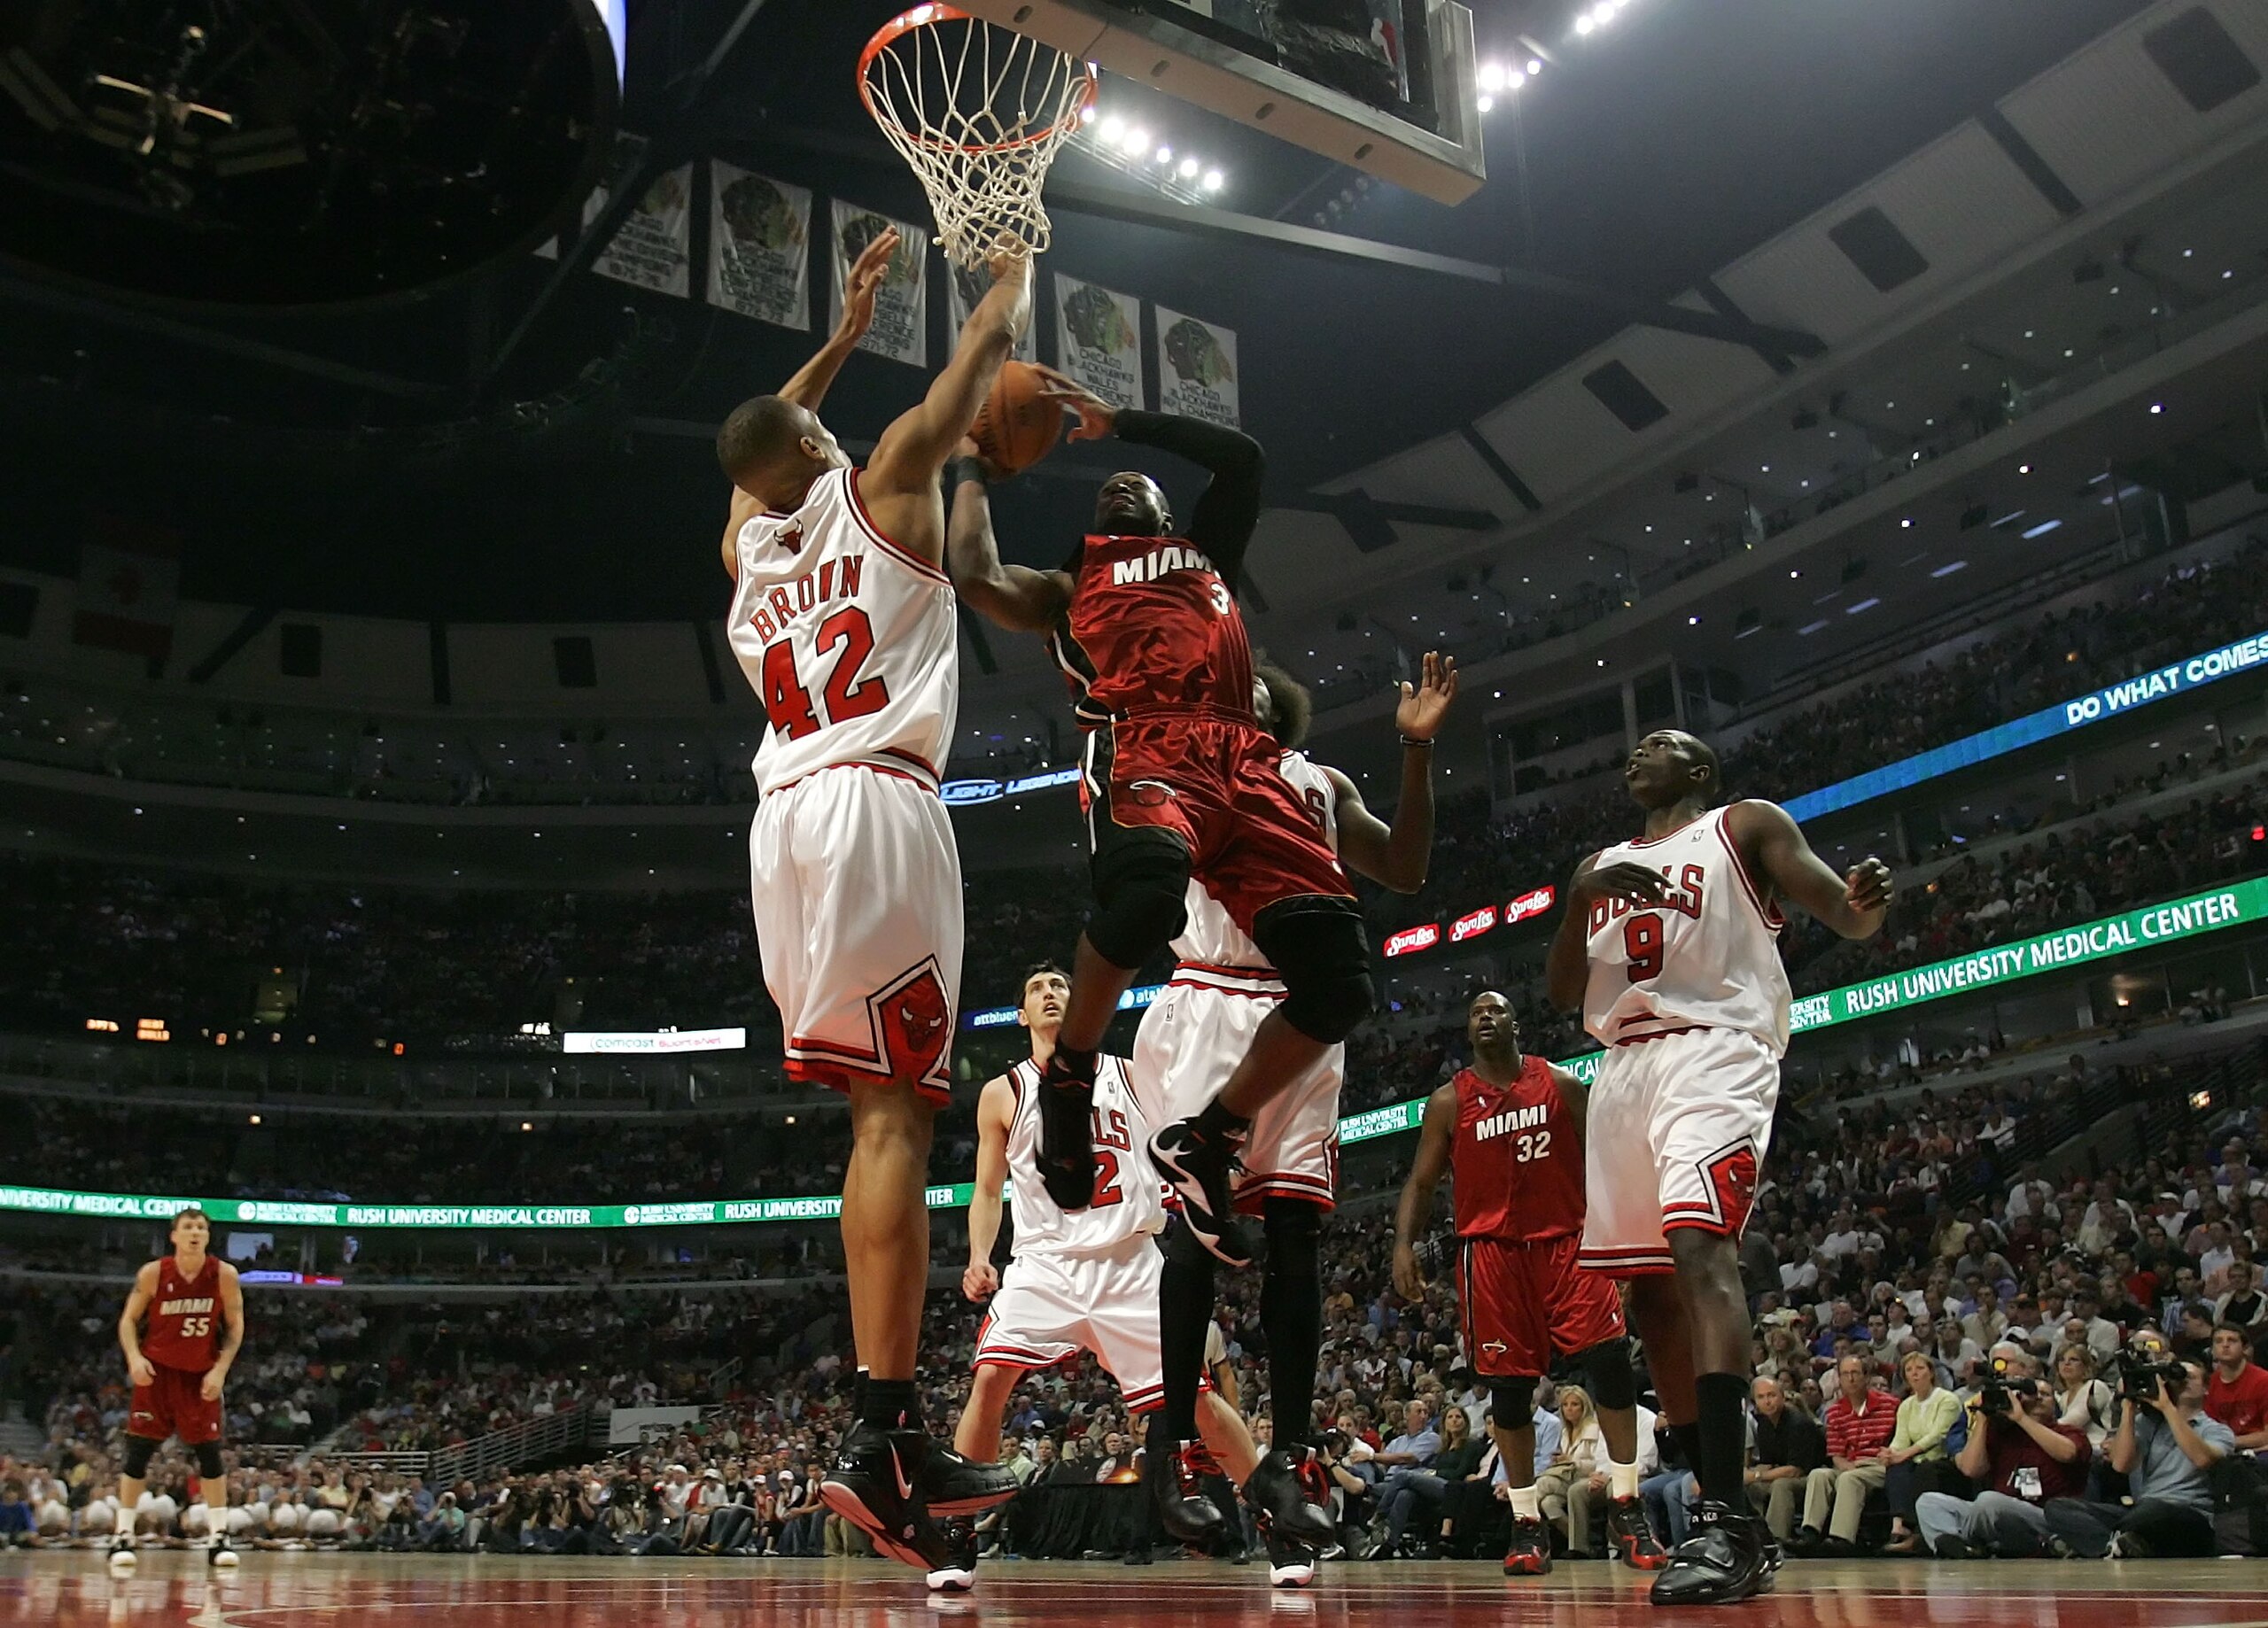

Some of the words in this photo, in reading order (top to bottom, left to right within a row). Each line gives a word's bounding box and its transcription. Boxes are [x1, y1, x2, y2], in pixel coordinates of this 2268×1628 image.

[1113, 547, 1222, 585] MIAM
[1210, 582, 1230, 616] 3
[762, 605, 890, 740] 42
[2066, 696, 2101, 725] DO
[2104, 667, 2179, 710] WHAT
[2186, 633, 2268, 682] COMES
[941, 783, 1002, 799] LIGHT
[1623, 912, 1664, 984] 9
[1846, 980, 1899, 1014] RUSH
[1904, 946, 2025, 999] UNIVERSITY
[2031, 920, 2136, 967] MEDICAL
[2140, 893, 2239, 939] CENTER
[1790, 995, 1829, 1017] ERSITY
[1790, 1008, 1832, 1030] ENTER
[595, 1037, 654, 1049] comcast
[1476, 1105, 1547, 1141] MIAMI
[1517, 1131, 1551, 1162] 32
[1091, 1150, 1123, 1209] 2
[0, 1188, 74, 1210] NIVERSITY
[74, 1194, 143, 1214] MEDICAL
[725, 1201, 763, 1220] RUSH
[764, 1198, 843, 1218] UNIVERSITY
[925, 1188, 953, 1205] TER
[347, 1207, 386, 1224] RUSH
[388, 1208, 470, 1225] UNIVERSITY
[471, 1208, 534, 1225] MEDICAL
[536, 1208, 591, 1225] CENTER
[160, 1298, 214, 1316] MIAMI
[180, 1317, 210, 1337] 55
